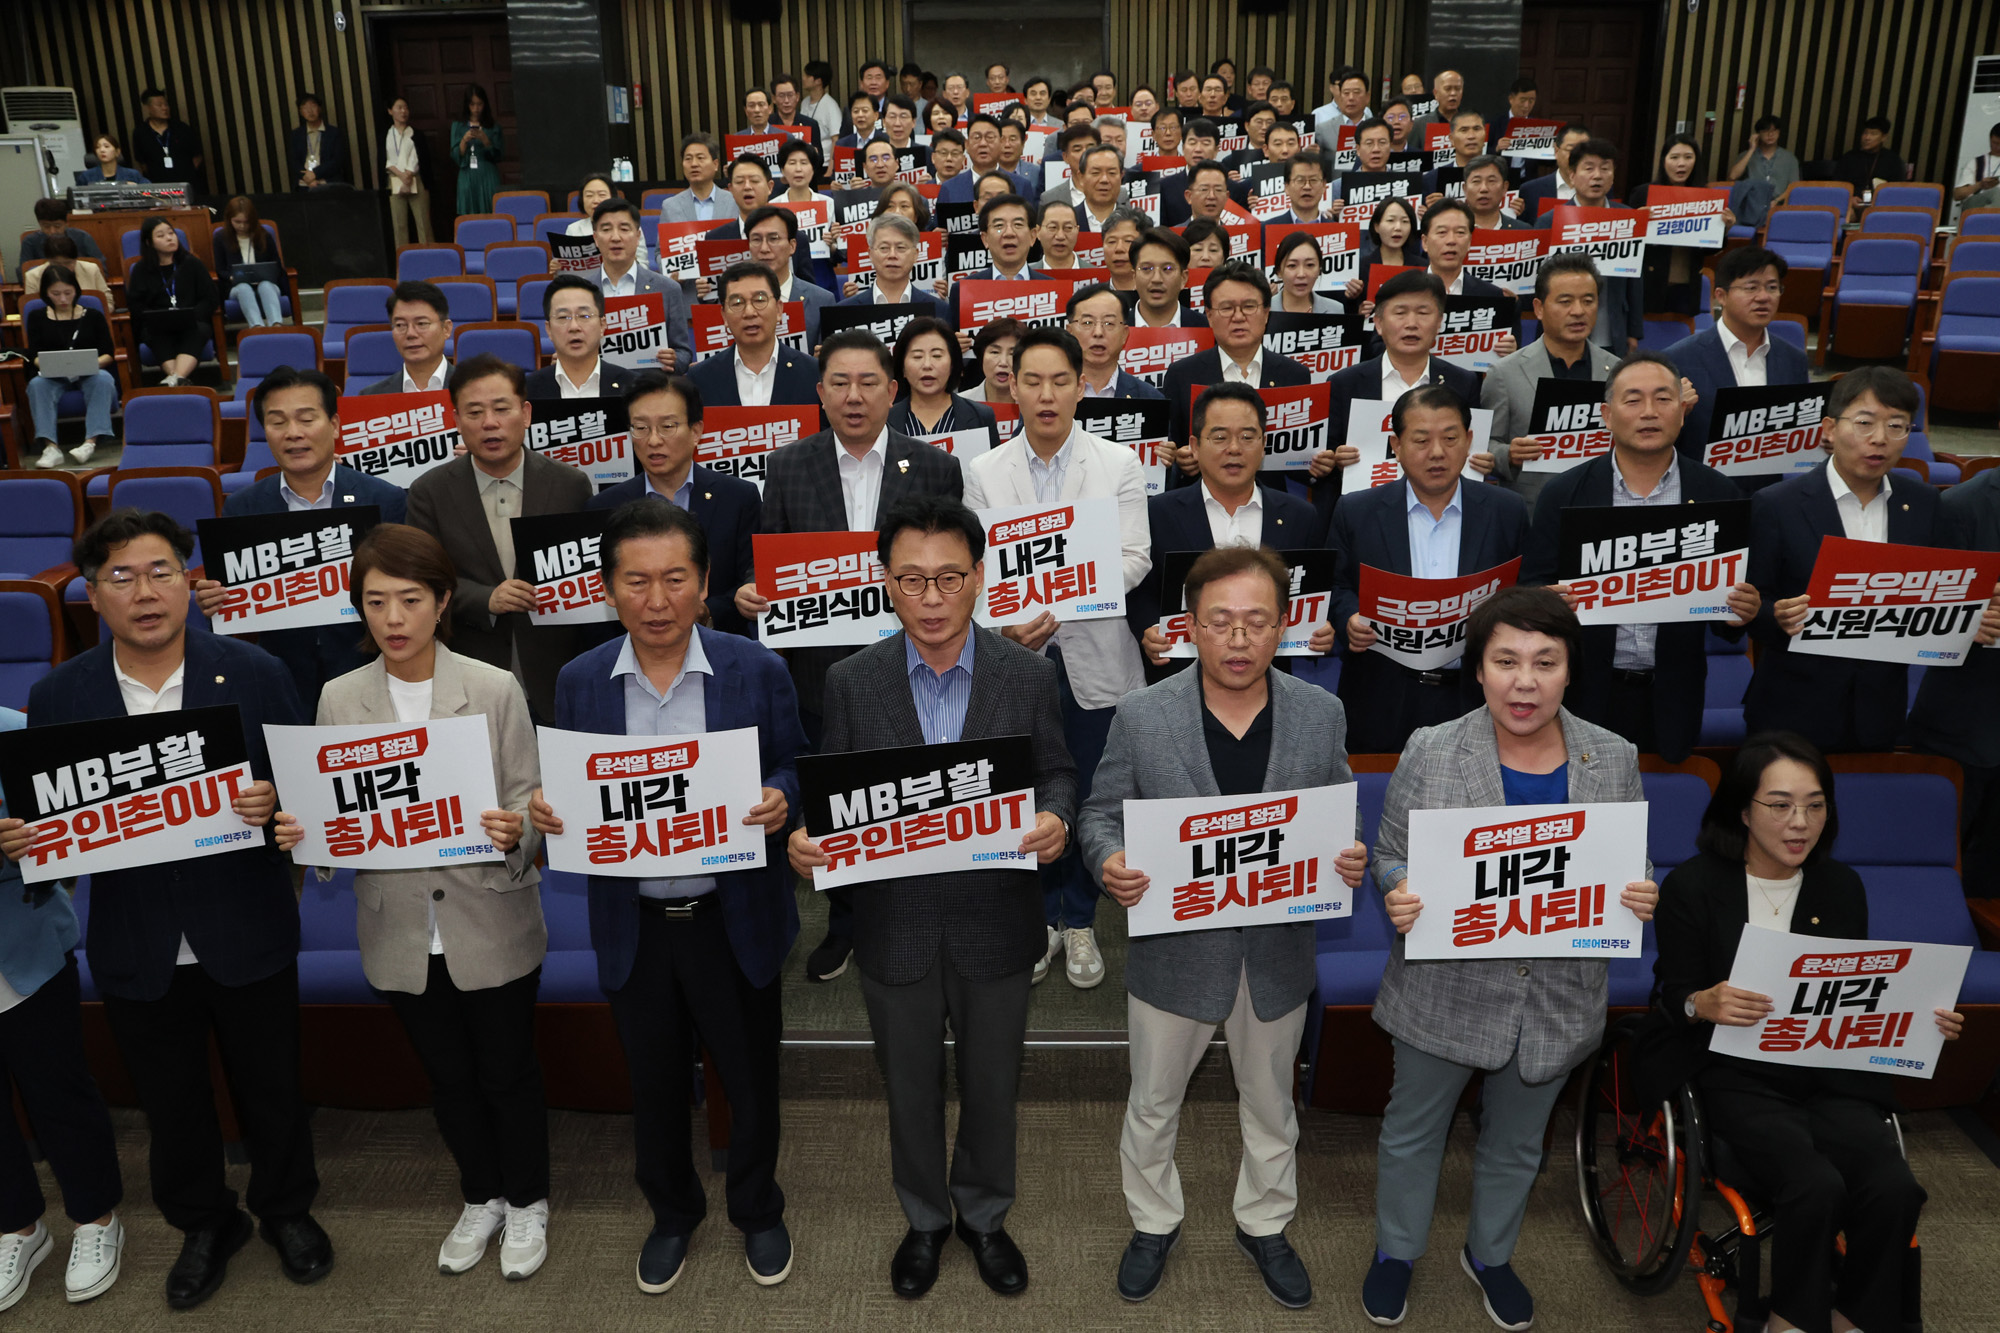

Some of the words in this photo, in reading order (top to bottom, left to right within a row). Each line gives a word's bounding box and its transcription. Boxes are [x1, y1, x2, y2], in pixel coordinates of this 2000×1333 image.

[1261, 176, 1285, 196] MB
[1349, 180, 1409, 204] MB부활
[1562, 218, 1636, 243] 극우막말
[1657, 217, 1712, 235] 김행OUT
[558, 242, 597, 258] MB부
[1468, 238, 1540, 264] 극우막말
[605, 304, 649, 331] 막말
[972, 291, 1058, 322] 극우막말
[1263, 325, 1345, 354] MB부활
[341, 403, 446, 450] 극우막말
[1722, 397, 1825, 439] MB부활
[697, 418, 802, 458] 극우막말
[1706, 425, 1825, 468] 유인촌OU
[995, 519, 1038, 542] 윤석열
[1038, 512, 1067, 530] 정권
[223, 523, 354, 585] MB부활
[533, 533, 602, 582] MB부
[999, 533, 1068, 579] 내각
[1580, 519, 1719, 576] MB부활
[987, 560, 1098, 619] 총사퇴!
[1570, 553, 1743, 612] 유인촌OUT
[1829, 568, 1978, 604] 극우막말
[1076, 602, 1119, 613] 더불어민주당
[1800, 603, 1983, 643] 신원식OUT
[1917, 650, 1961, 661] 더불어민주당
[325, 743, 378, 768] 윤석열
[380, 734, 419, 760] 정권
[595, 753, 648, 776] 윤석열
[651, 747, 689, 769] 정권
[32, 730, 208, 815] MB부활
[332, 761, 423, 815] 내각
[600, 773, 689, 823] 내각
[829, 758, 994, 830] MB부활
[27, 768, 246, 867] 유인촌OUT
[324, 795, 466, 858] 총사퇴!
[586, 804, 730, 866] 총사퇴!
[818, 793, 1028, 872] 유인촌OUT
[1189, 811, 1246, 837] 윤석열
[1248, 803, 1288, 829] 정권
[1473, 826, 1531, 852] 윤석열
[1534, 818, 1573, 843] 정권
[194, 831, 253, 849] 더불어민주당
[438, 844, 495, 859] 더불어민주당
[701, 851, 757, 866] 더불어민주당
[972, 849, 1027, 863] 더불어민주당
[1192, 828, 1284, 881] 내각
[1173, 858, 1318, 923] 총사퇴!
[1475, 847, 1571, 901] 내각
[1287, 901, 1343, 916] 더불어민주당
[1452, 884, 1606, 949] 총사퇴!
[1571, 937, 1631, 952] 더불어민주당
[1801, 957, 1860, 975] 윤석열
[1860, 954, 1900, 972] 정권
[1790, 977, 1889, 1016] 내각
[1758, 1012, 1914, 1052] 총사퇴!
[1869, 1055, 1926, 1071] 더불어민주당
